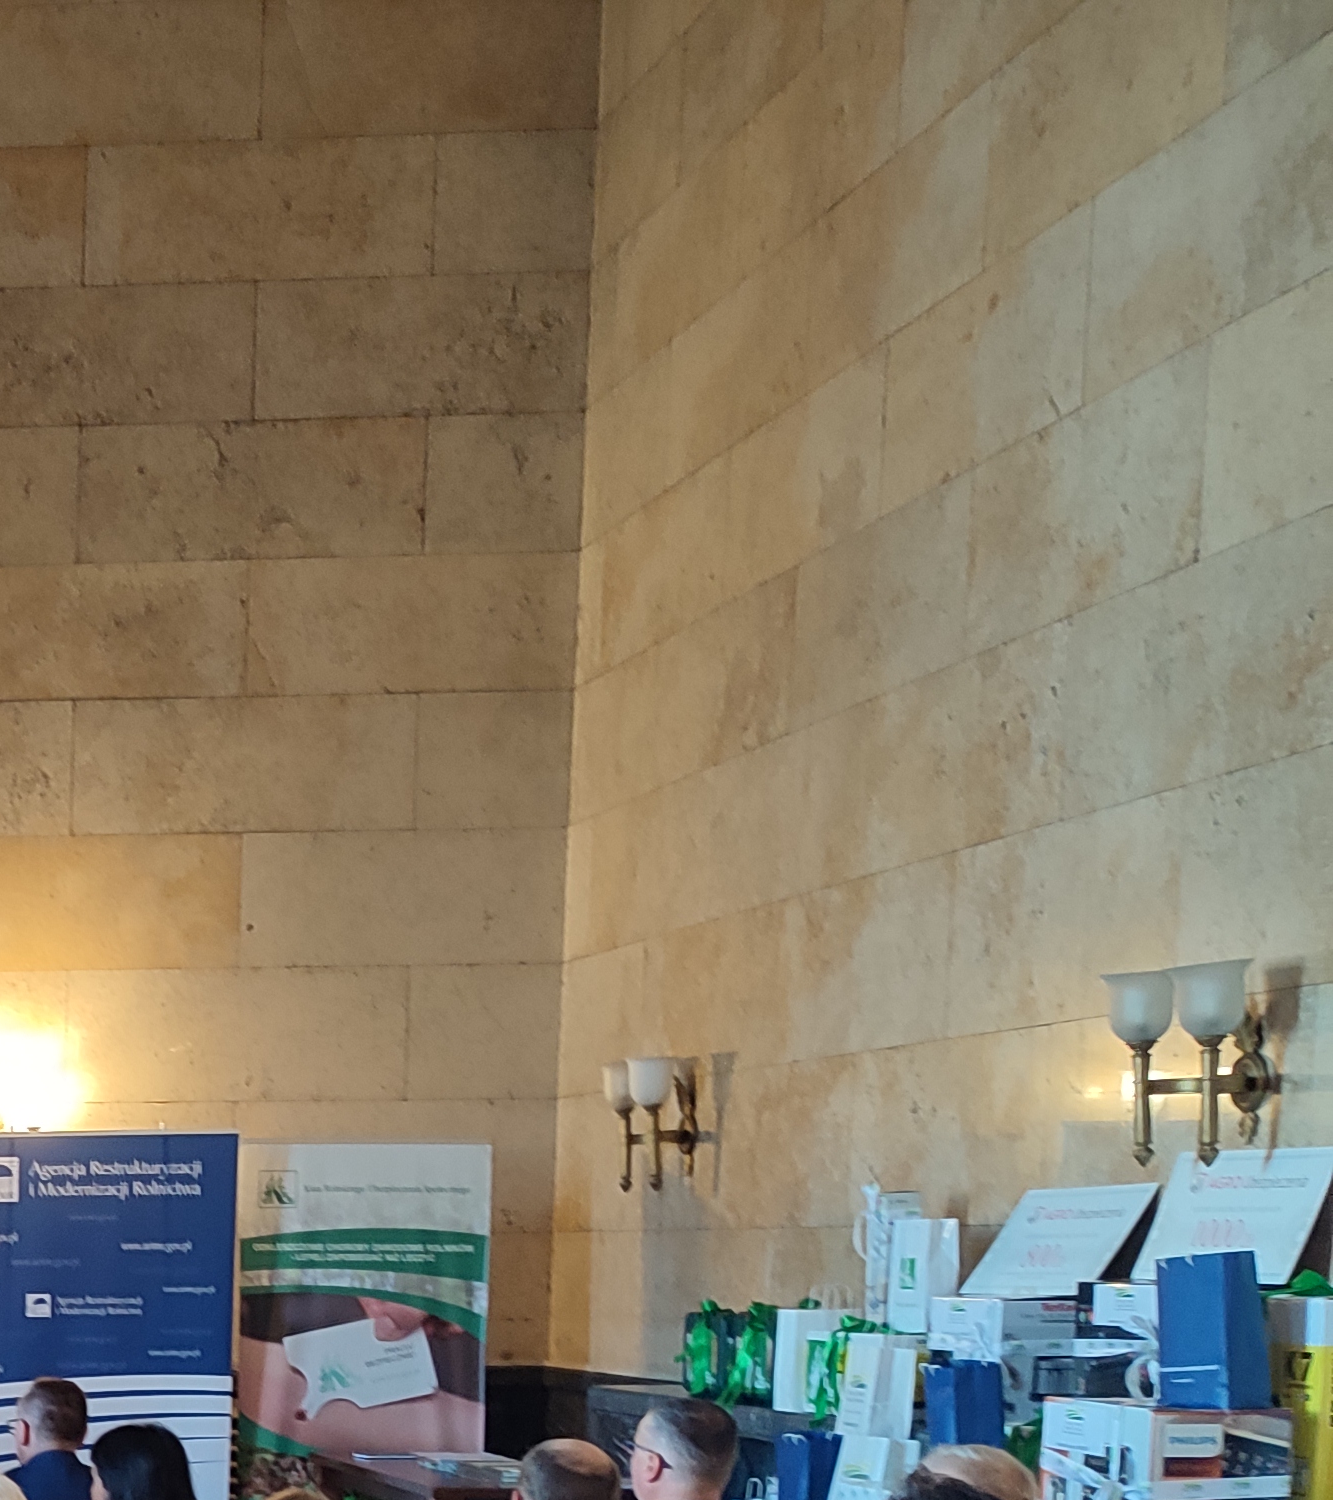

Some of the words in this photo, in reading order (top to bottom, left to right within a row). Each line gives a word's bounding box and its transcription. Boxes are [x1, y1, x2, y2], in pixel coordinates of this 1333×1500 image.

[29, 1160, 86, 1181] Agencja
[89, 1158, 203, 1180] Restrukturyzacji
[38, 1181, 129, 1201] Modernizacji
